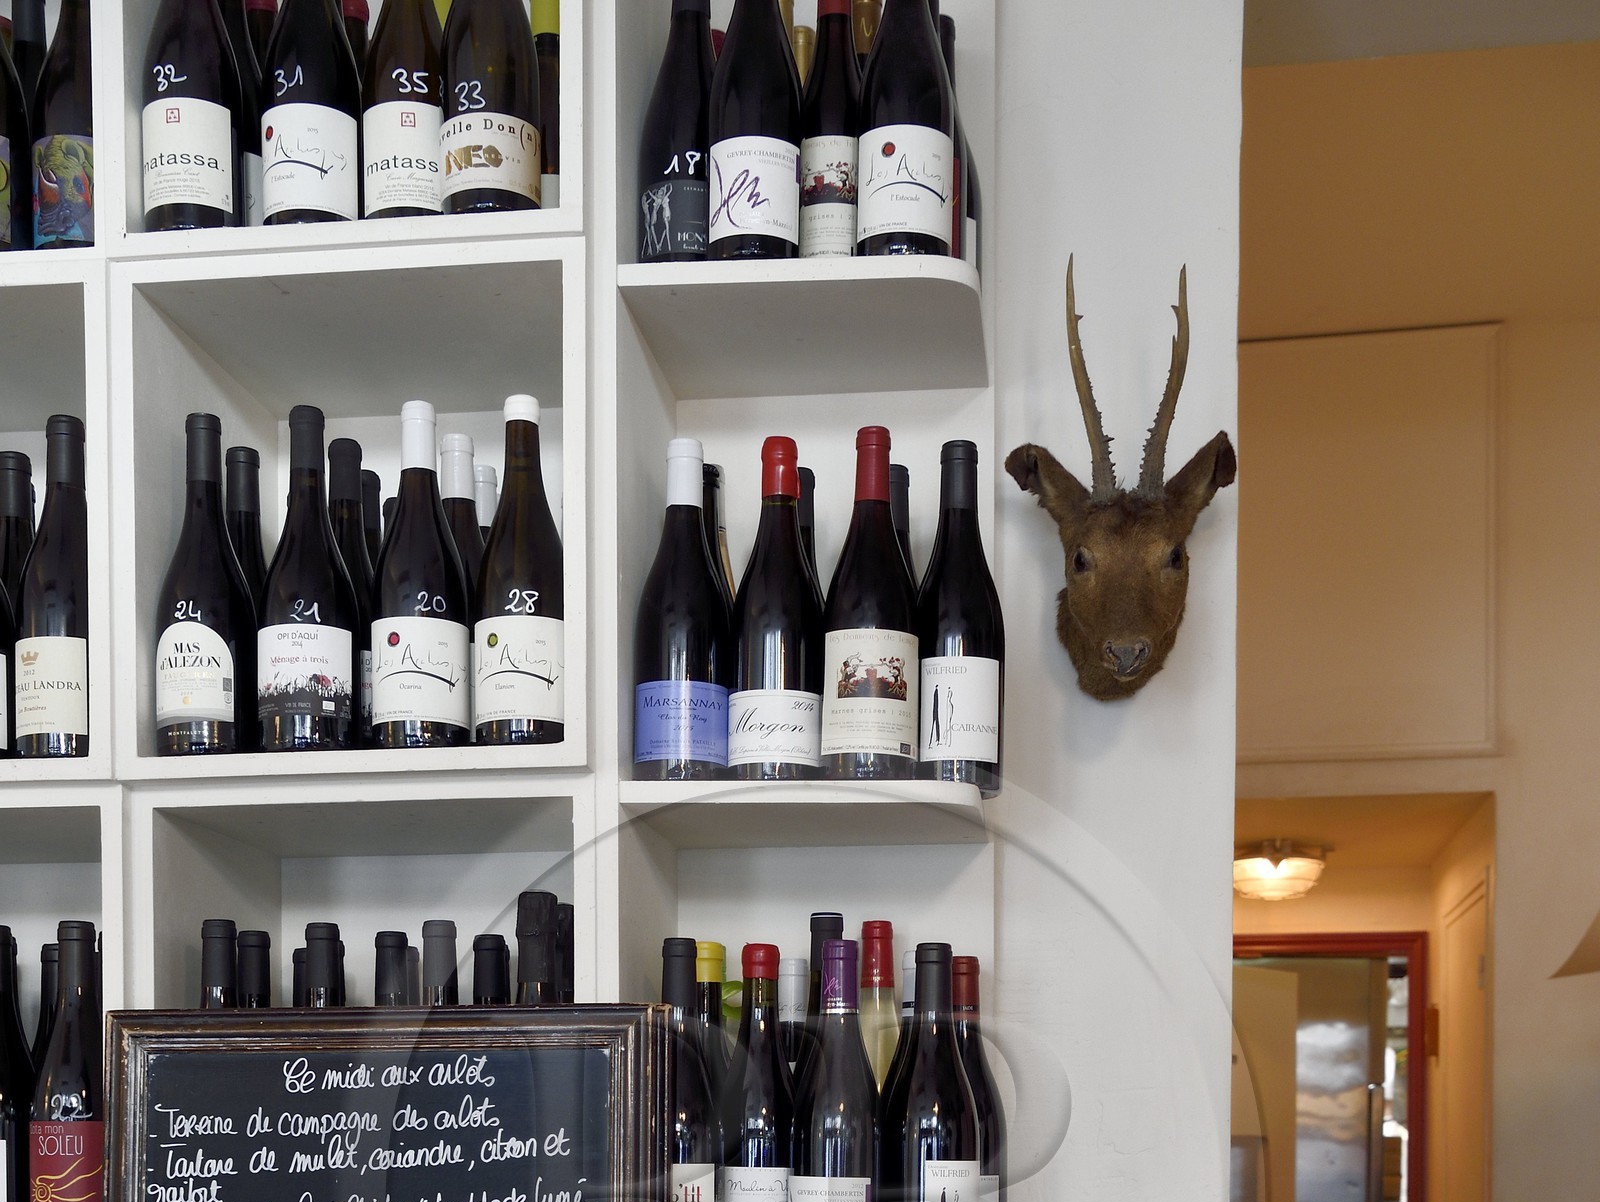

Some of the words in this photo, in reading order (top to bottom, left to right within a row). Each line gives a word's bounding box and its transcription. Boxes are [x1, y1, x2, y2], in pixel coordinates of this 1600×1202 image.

[153, 64, 187, 92] 32
[274, 64, 304, 97] 31
[391, 67, 429, 94] 35
[454, 80, 487, 111] 33
[664, 151, 700, 174] 18
[174, 600, 202, 621] 24
[289, 599, 322, 623] 21
[414, 591, 447, 612] 20
[504, 588, 540, 614] 28
[277, 632, 289, 641] OPI
[173, 642, 201, 654] MAS
[160, 655, 221, 671] d'ALEZON
[270, 656, 300, 666] Ménage
[310, 656, 329, 664] trois
[925, 665, 967, 676] WILFRIED
[33, 680, 82, 692] LANDRA
[643, 696, 723, 710] MARSANNAY
[791, 701, 814, 712] 2014
[729, 707, 806, 740] Morgon
[951, 723, 998, 735] CAIRANNE
[321, 1060, 375, 1091] midi
[380, 1063, 422, 1089] aux
[50, 1092, 93, 1120] 22
[44, 1124, 64, 1134] mon
[154, 1104, 238, 1139] Terrine
[246, 1106, 274, 1138] de
[277, 1111, 382, 1150] campagne
[391, 1104, 429, 1132] des
[38, 1135, 84, 1156] SOLEU
[160, 1142, 239, 1179] Tartare
[248, 1145, 279, 1174] de
[479, 1128, 537, 1164] citron
[542, 1127, 571, 1157] et
[931, 1169, 970, 1178] WILFRIED
[727, 1180, 767, 1192] Moulin
[797, 1189, 864, 1197] GEVREY-CHAMBERTIN
